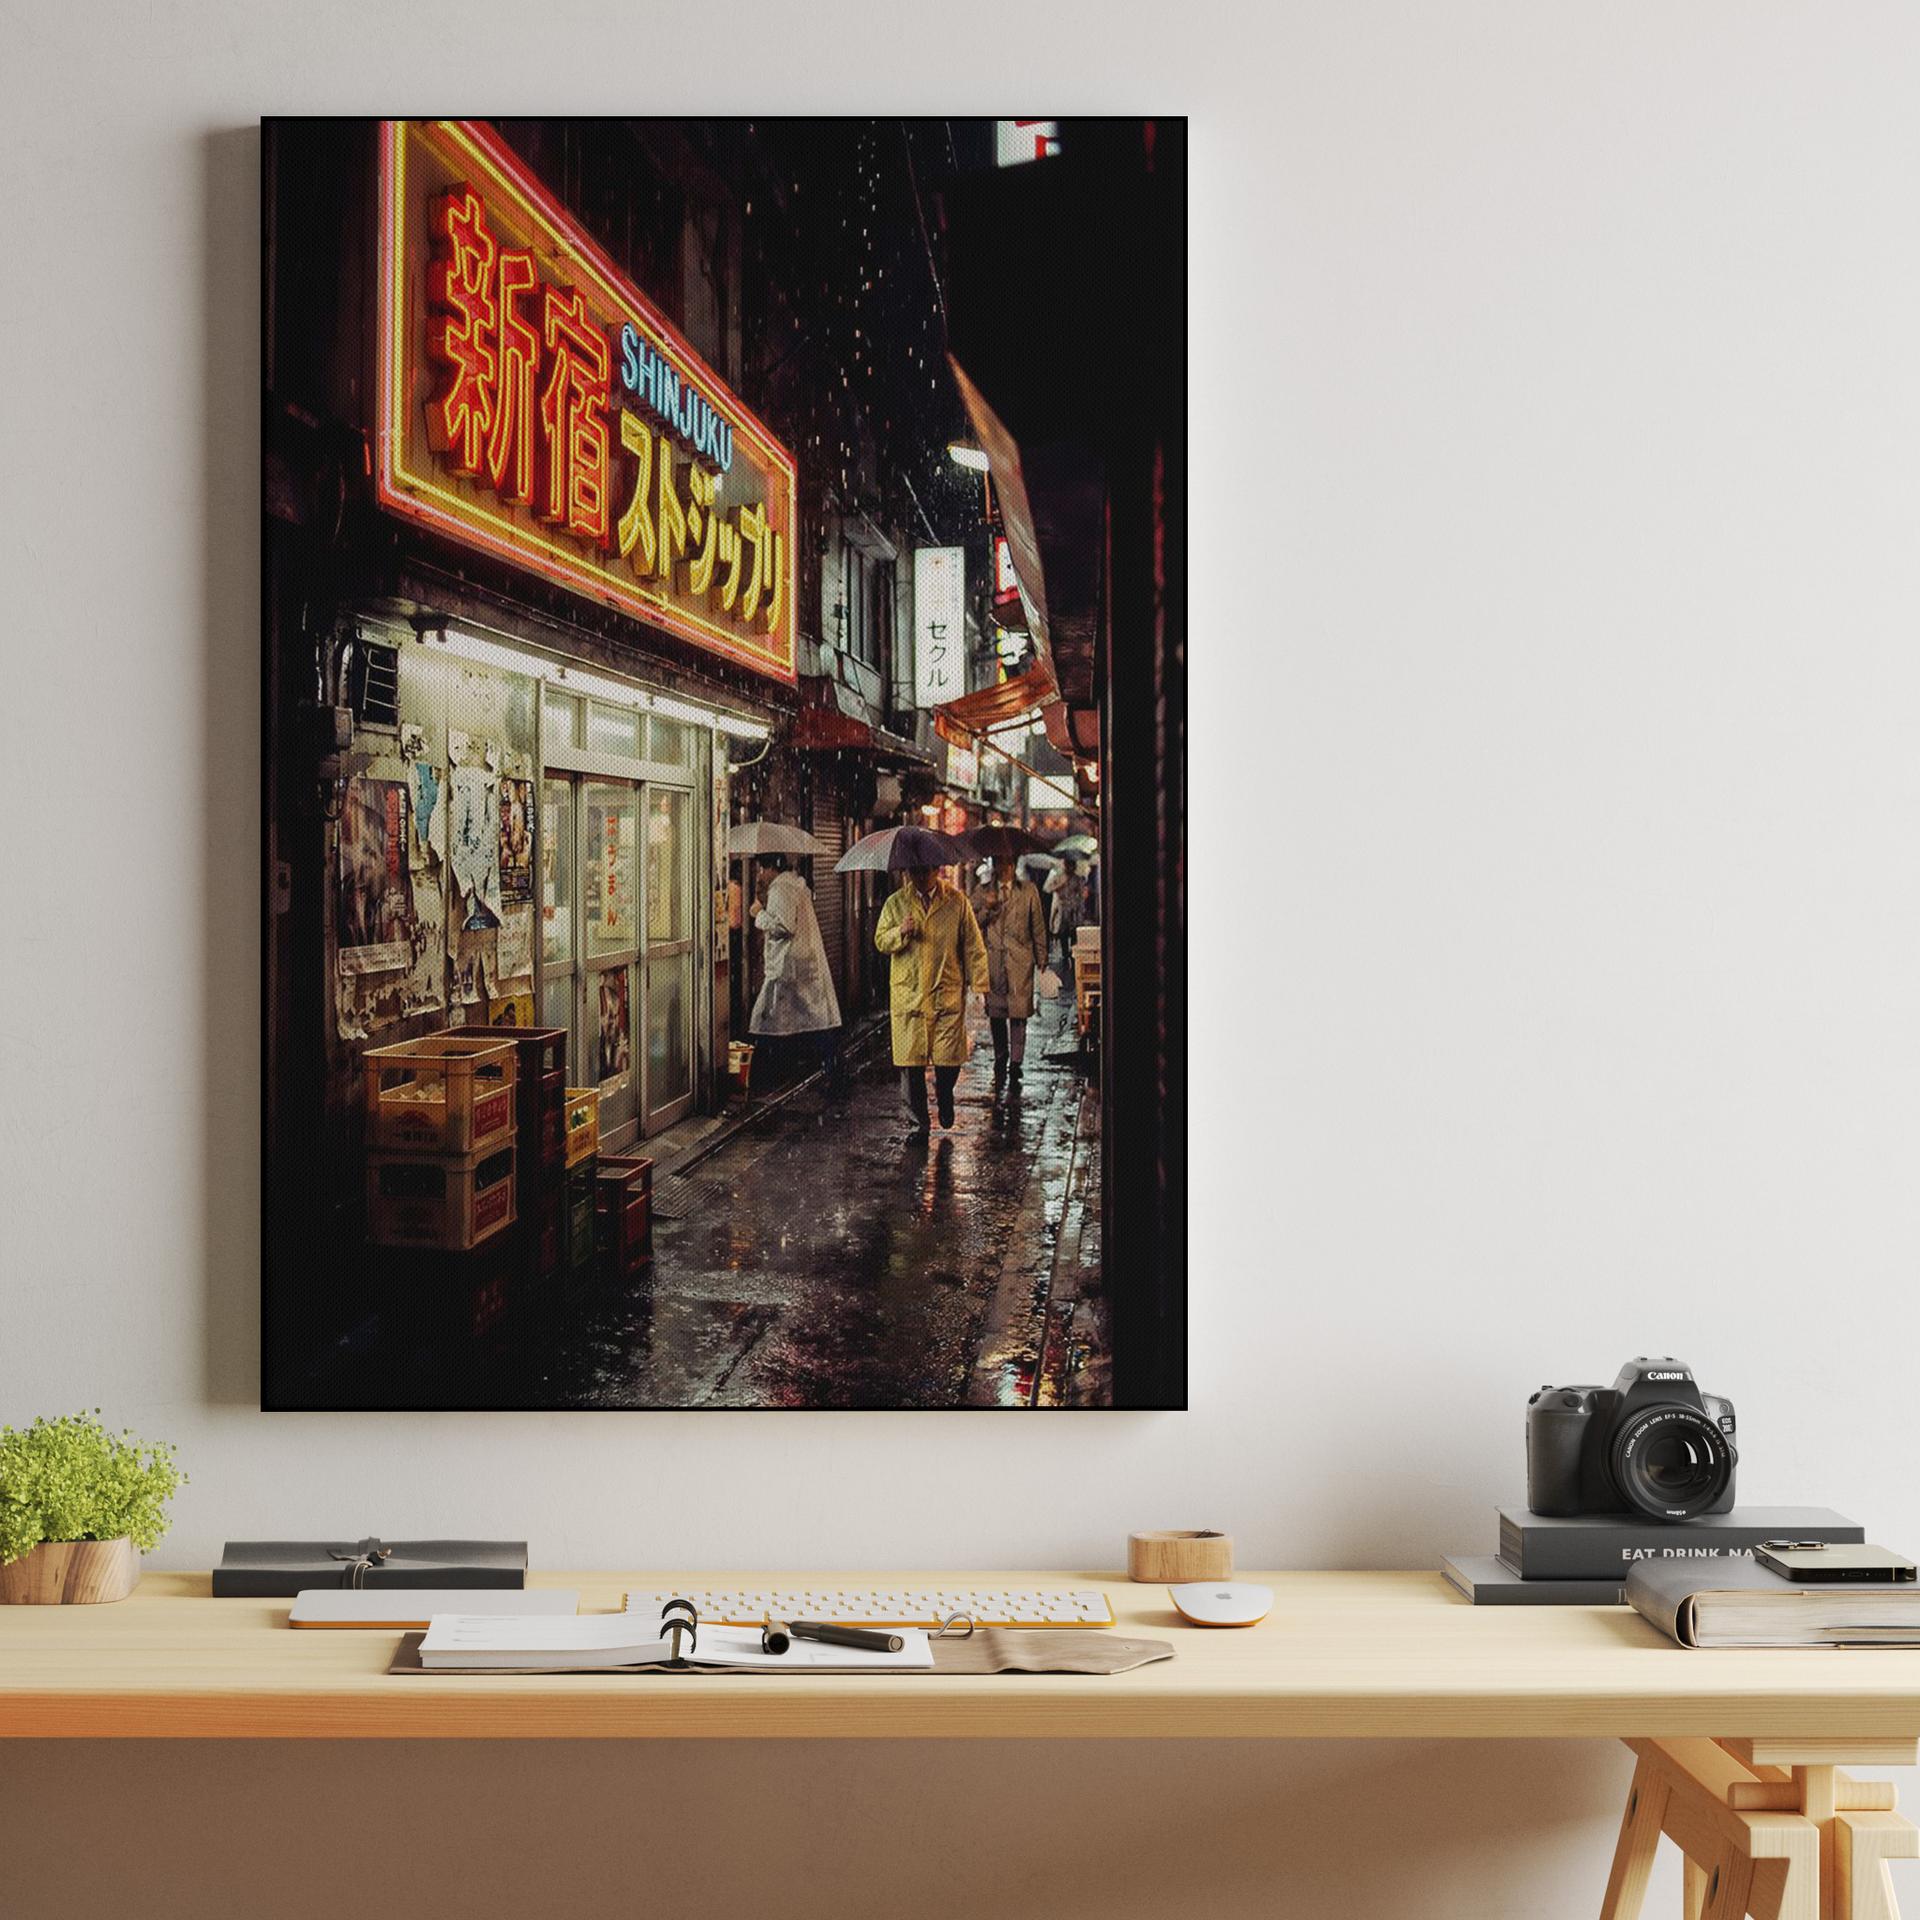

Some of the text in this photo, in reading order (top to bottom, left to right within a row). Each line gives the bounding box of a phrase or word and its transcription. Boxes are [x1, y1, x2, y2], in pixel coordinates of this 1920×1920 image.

[443, 192, 609, 543] 新宿
[621, 322, 733, 473] SHINJUKU
[926, 620, 949, 688] セクル
[1647, 1371, 1683, 1380] Canon
[1625, 1438, 1636, 1458] CANON
[1634, 1423, 1649, 1438] ZOOM
[1649, 1415, 1663, 1425] LENS
[1622, 1548, 1656, 1560] EAT
[1663, 1548, 1720, 1558] DRINK
